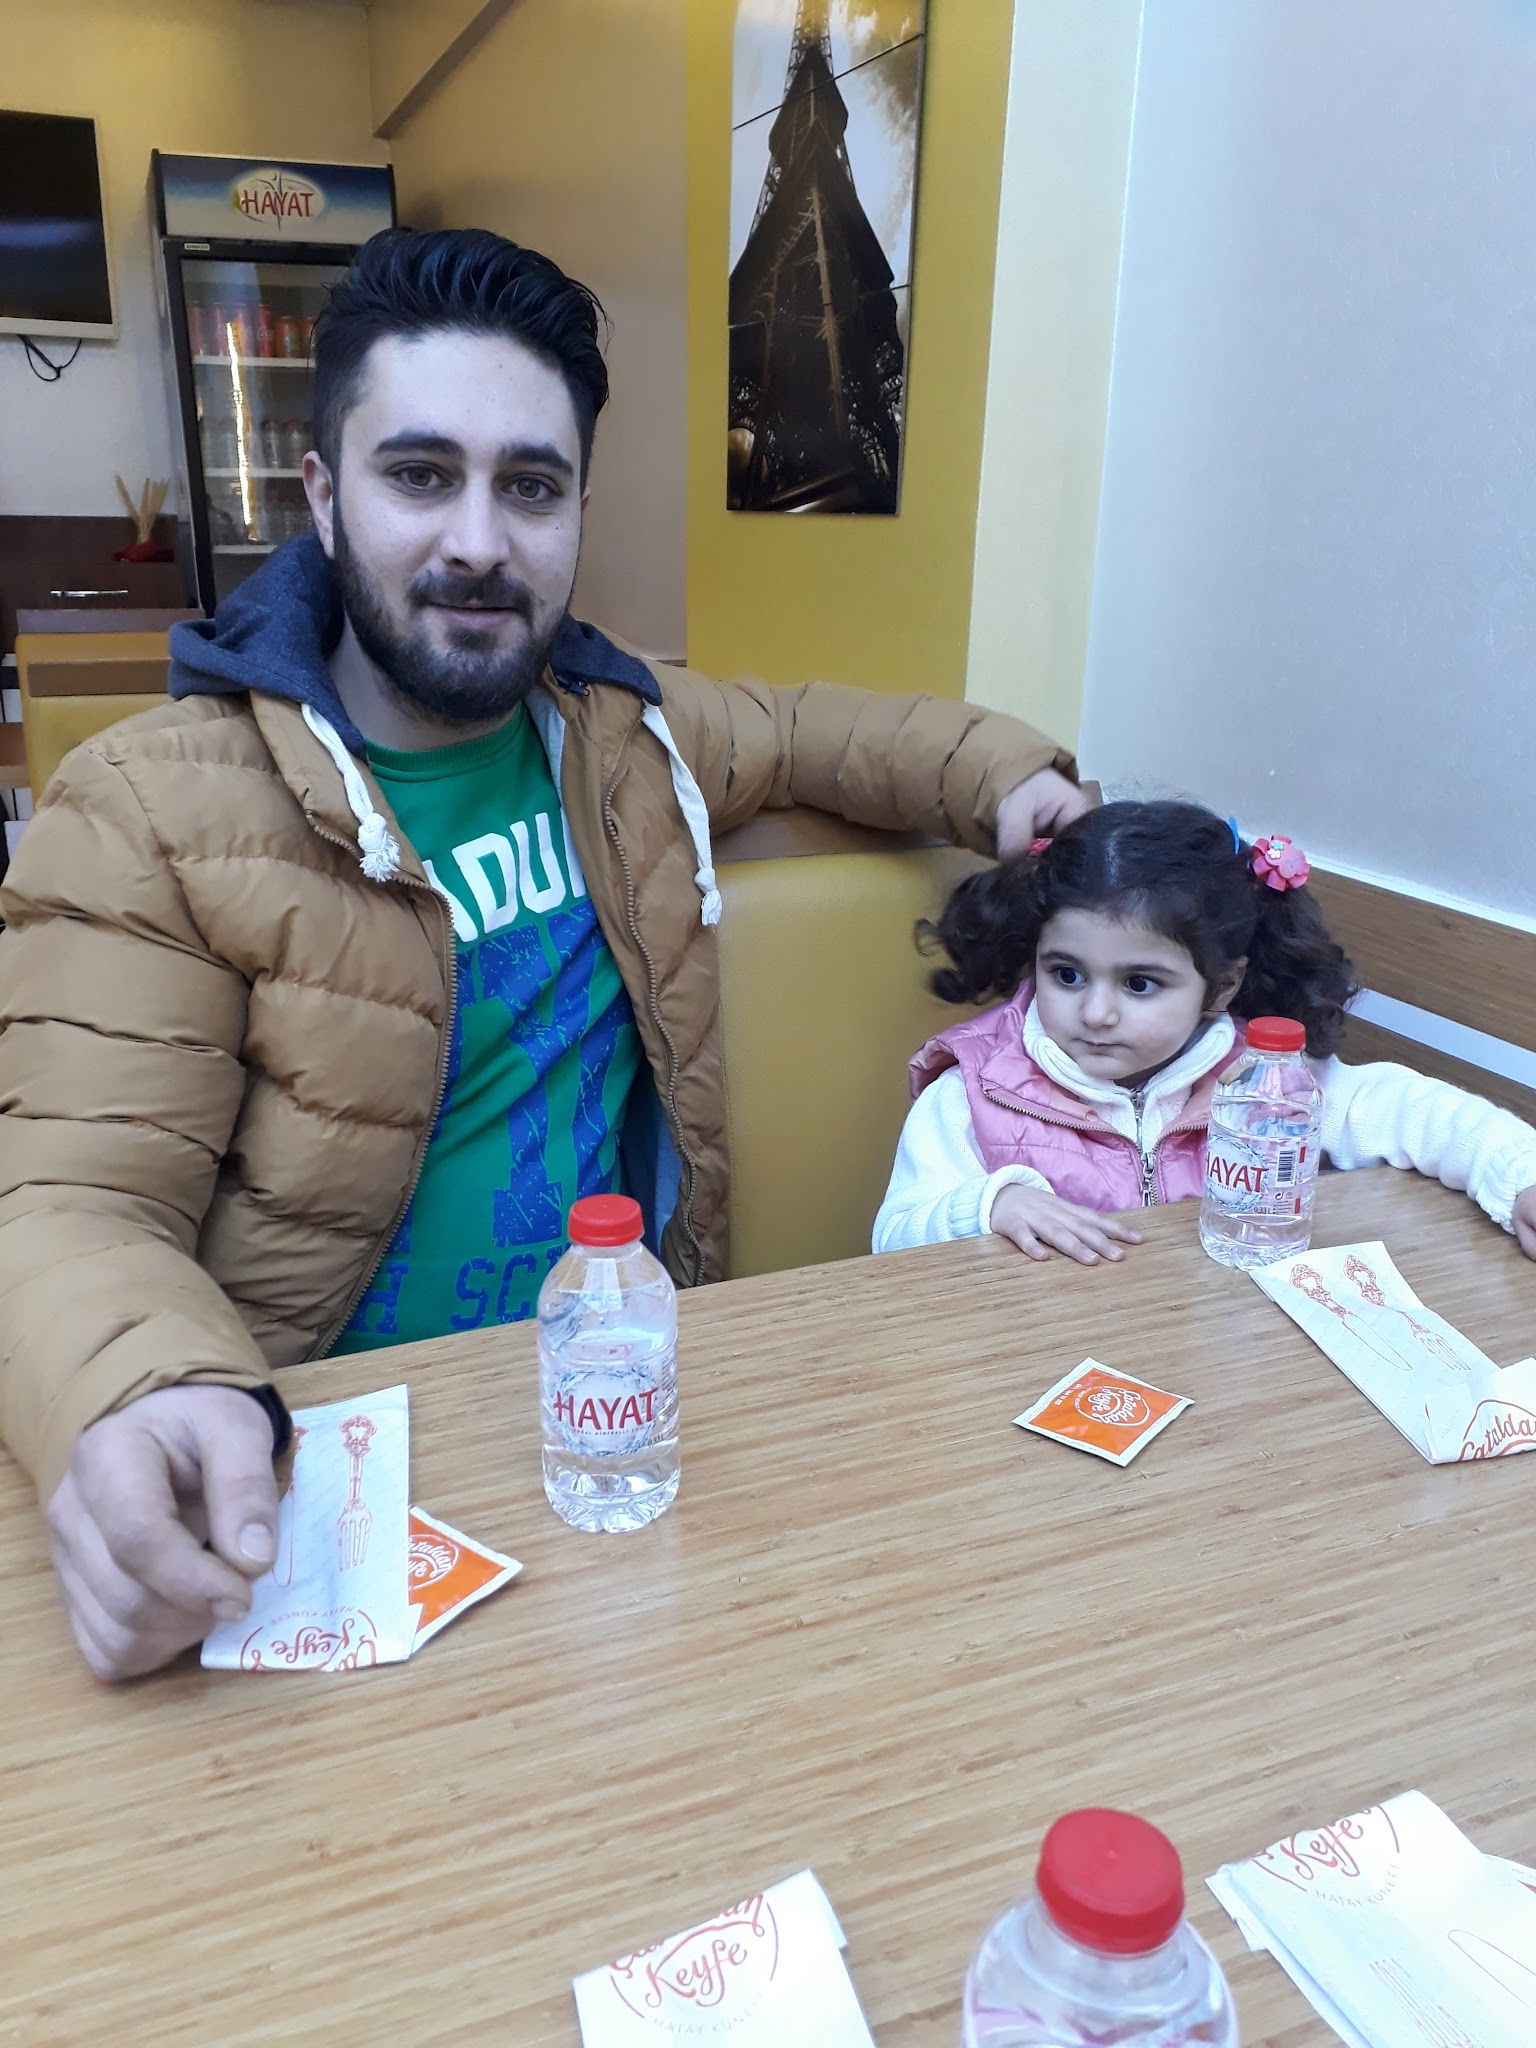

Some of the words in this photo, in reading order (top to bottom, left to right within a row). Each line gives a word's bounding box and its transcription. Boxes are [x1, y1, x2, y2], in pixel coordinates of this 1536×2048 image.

[241, 189, 314, 218] HAYAT
[553, 1388, 659, 1431] HAYAT
[271, 1618, 355, 1664] Keyfe
[645, 1939, 748, 2008] Keyfe
